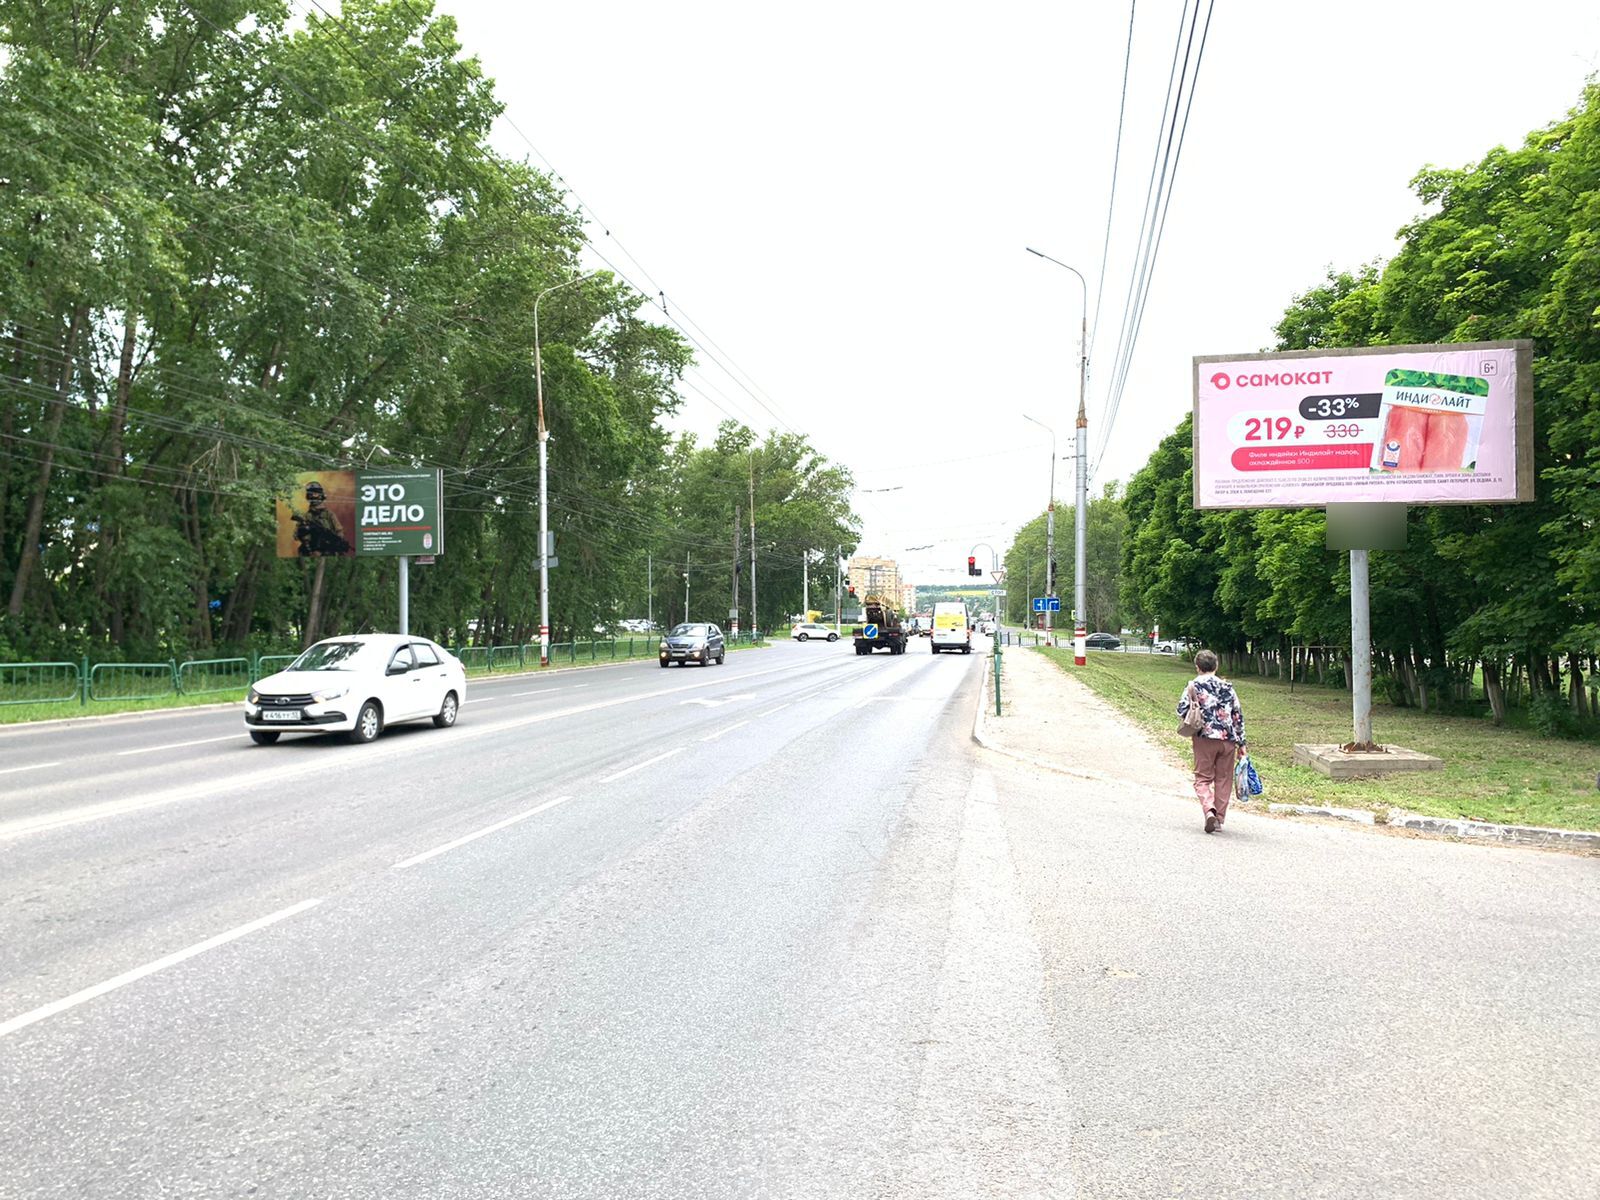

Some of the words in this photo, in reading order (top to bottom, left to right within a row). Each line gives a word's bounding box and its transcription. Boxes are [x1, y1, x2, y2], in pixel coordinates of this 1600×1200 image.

[1483, 363, 1495, 374] 6+
[1308, 398, 1360, 417] -33%
[1324, 424, 1363, 438] 330
[361, 484, 405, 502] ЭТО
[361, 504, 425, 526] ДЕЛО
